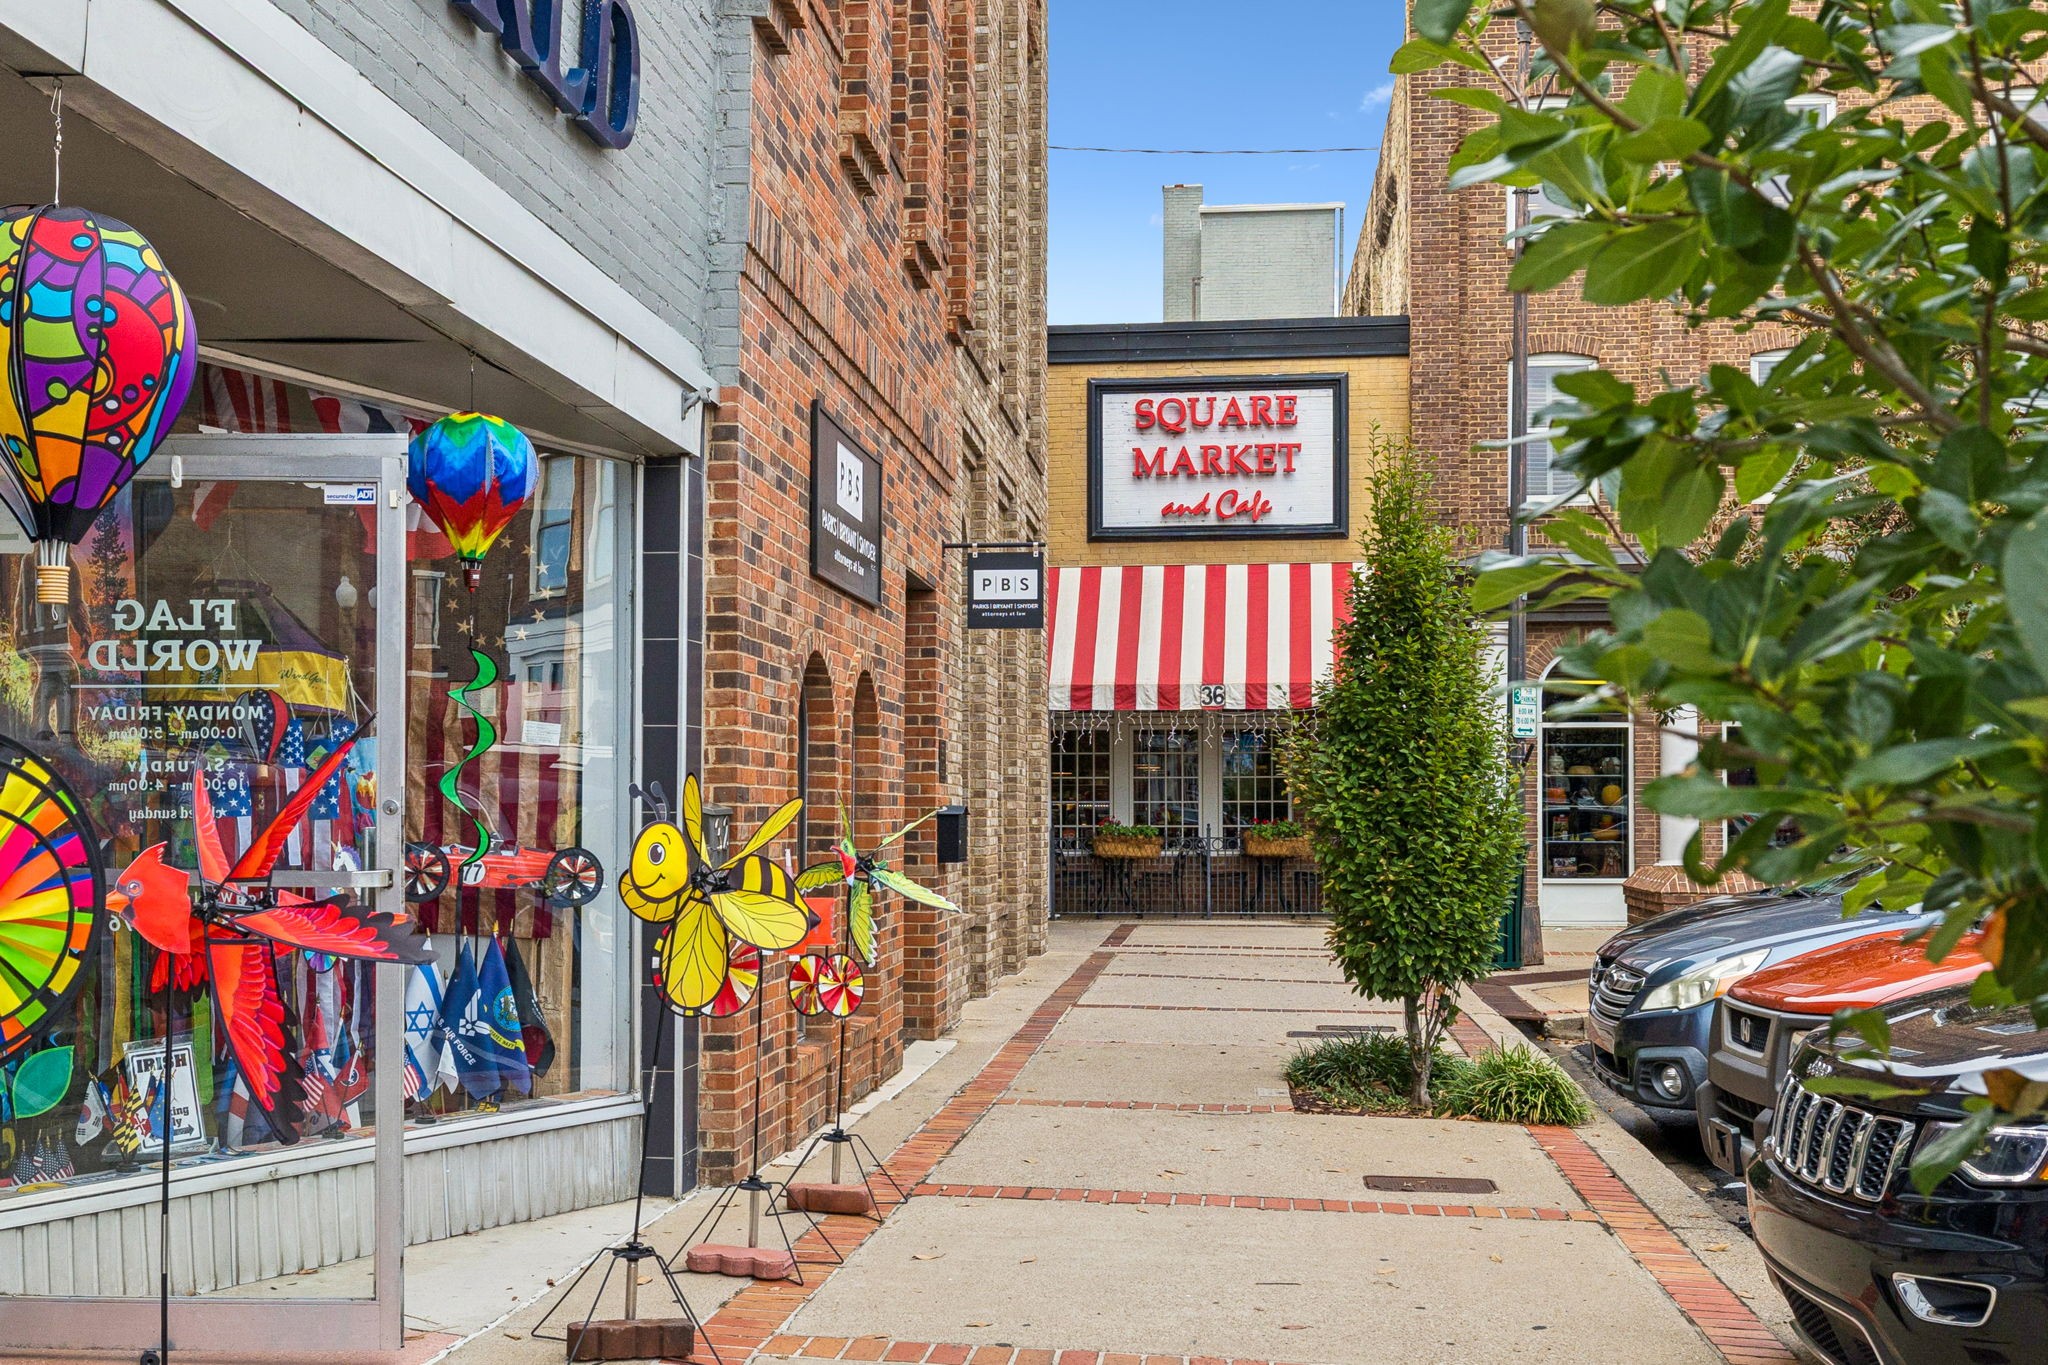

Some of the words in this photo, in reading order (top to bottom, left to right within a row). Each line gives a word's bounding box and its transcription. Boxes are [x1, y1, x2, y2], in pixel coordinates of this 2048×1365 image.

[1134, 395, 1299, 433] SQUARE
[1131, 443, 1302, 477] MARKET
[357, 490, 374, 500] ADT
[1161, 492, 1211, 517] and
[1216, 489, 1273, 522] Cafe
[1201, 685, 1226, 705] 36
[1514, 688, 1521, 702] 3
[463, 863, 483, 882] 77
[453, 1039, 477, 1066] FORCE
